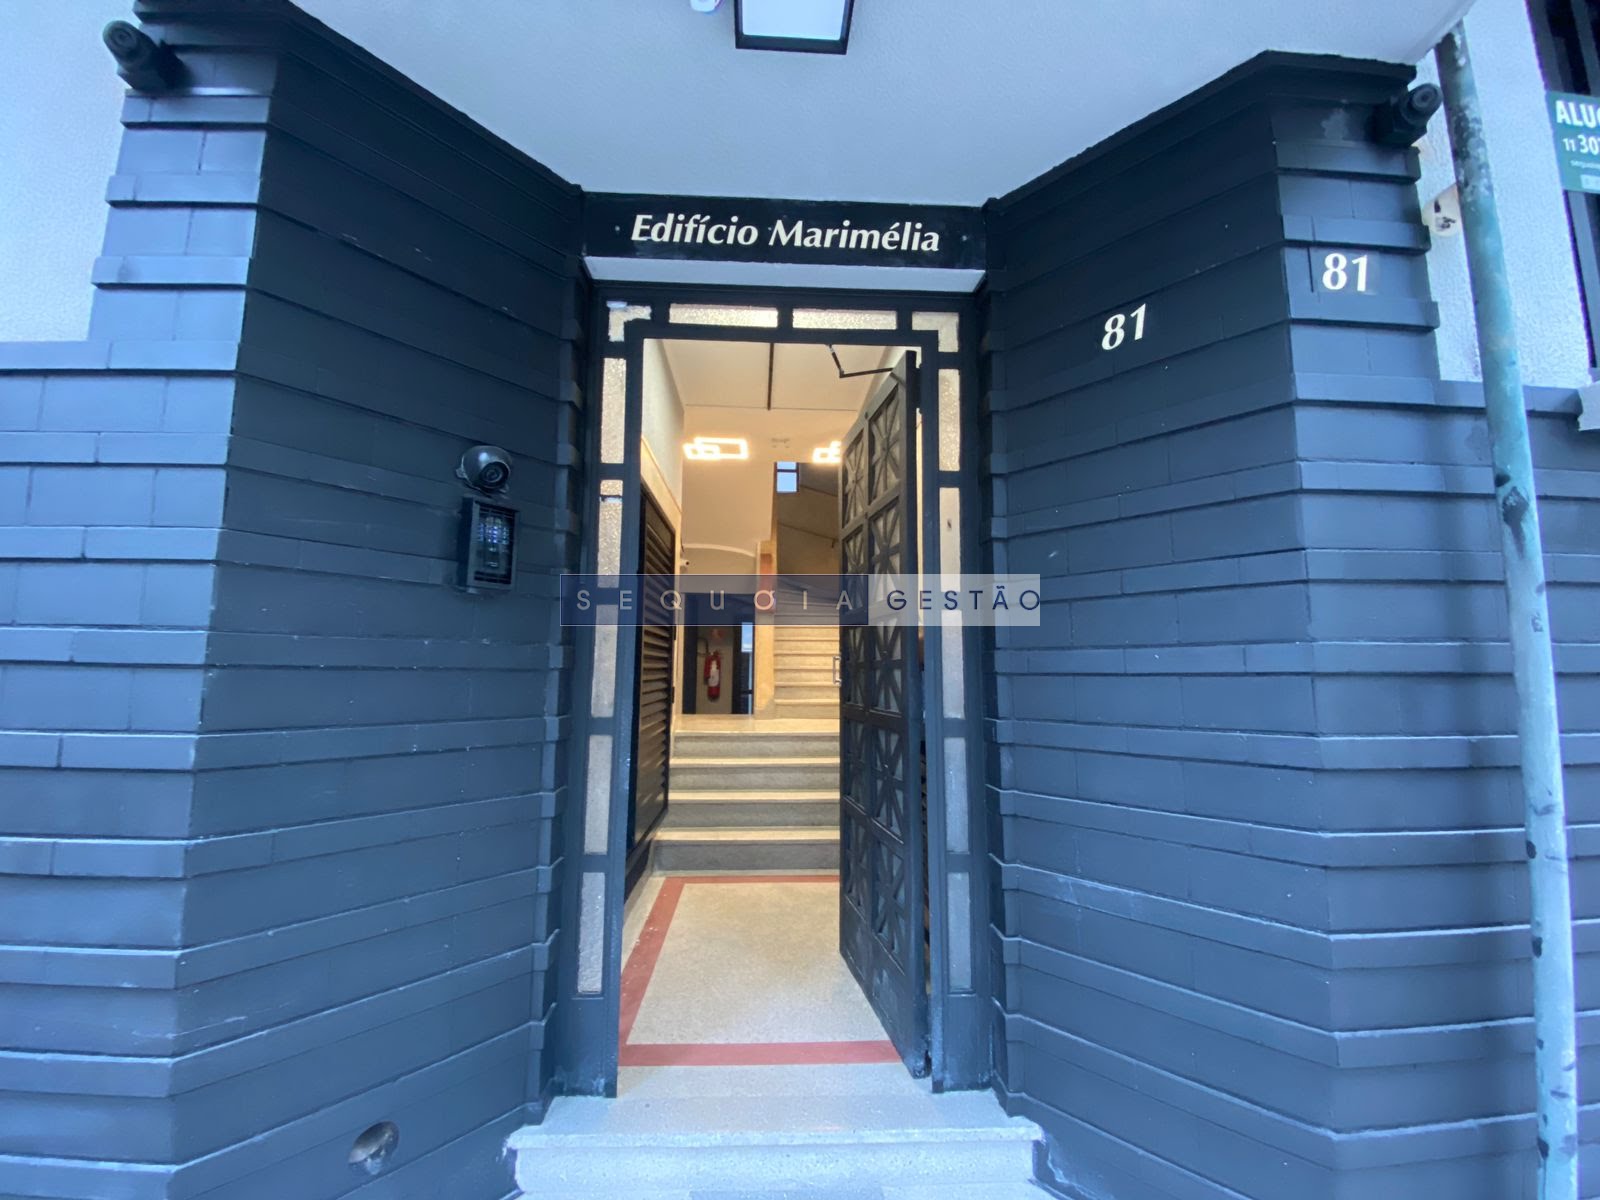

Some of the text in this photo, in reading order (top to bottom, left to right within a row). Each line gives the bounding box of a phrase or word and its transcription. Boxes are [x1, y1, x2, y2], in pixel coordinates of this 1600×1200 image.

[1555, 100, 1600, 128] ALU
[1563, 134, 1600, 155] 11 30
[631, 213, 940, 252] Edifício Marimélia
[1322, 252, 1368, 292] 81
[1101, 303, 1147, 351] 81
